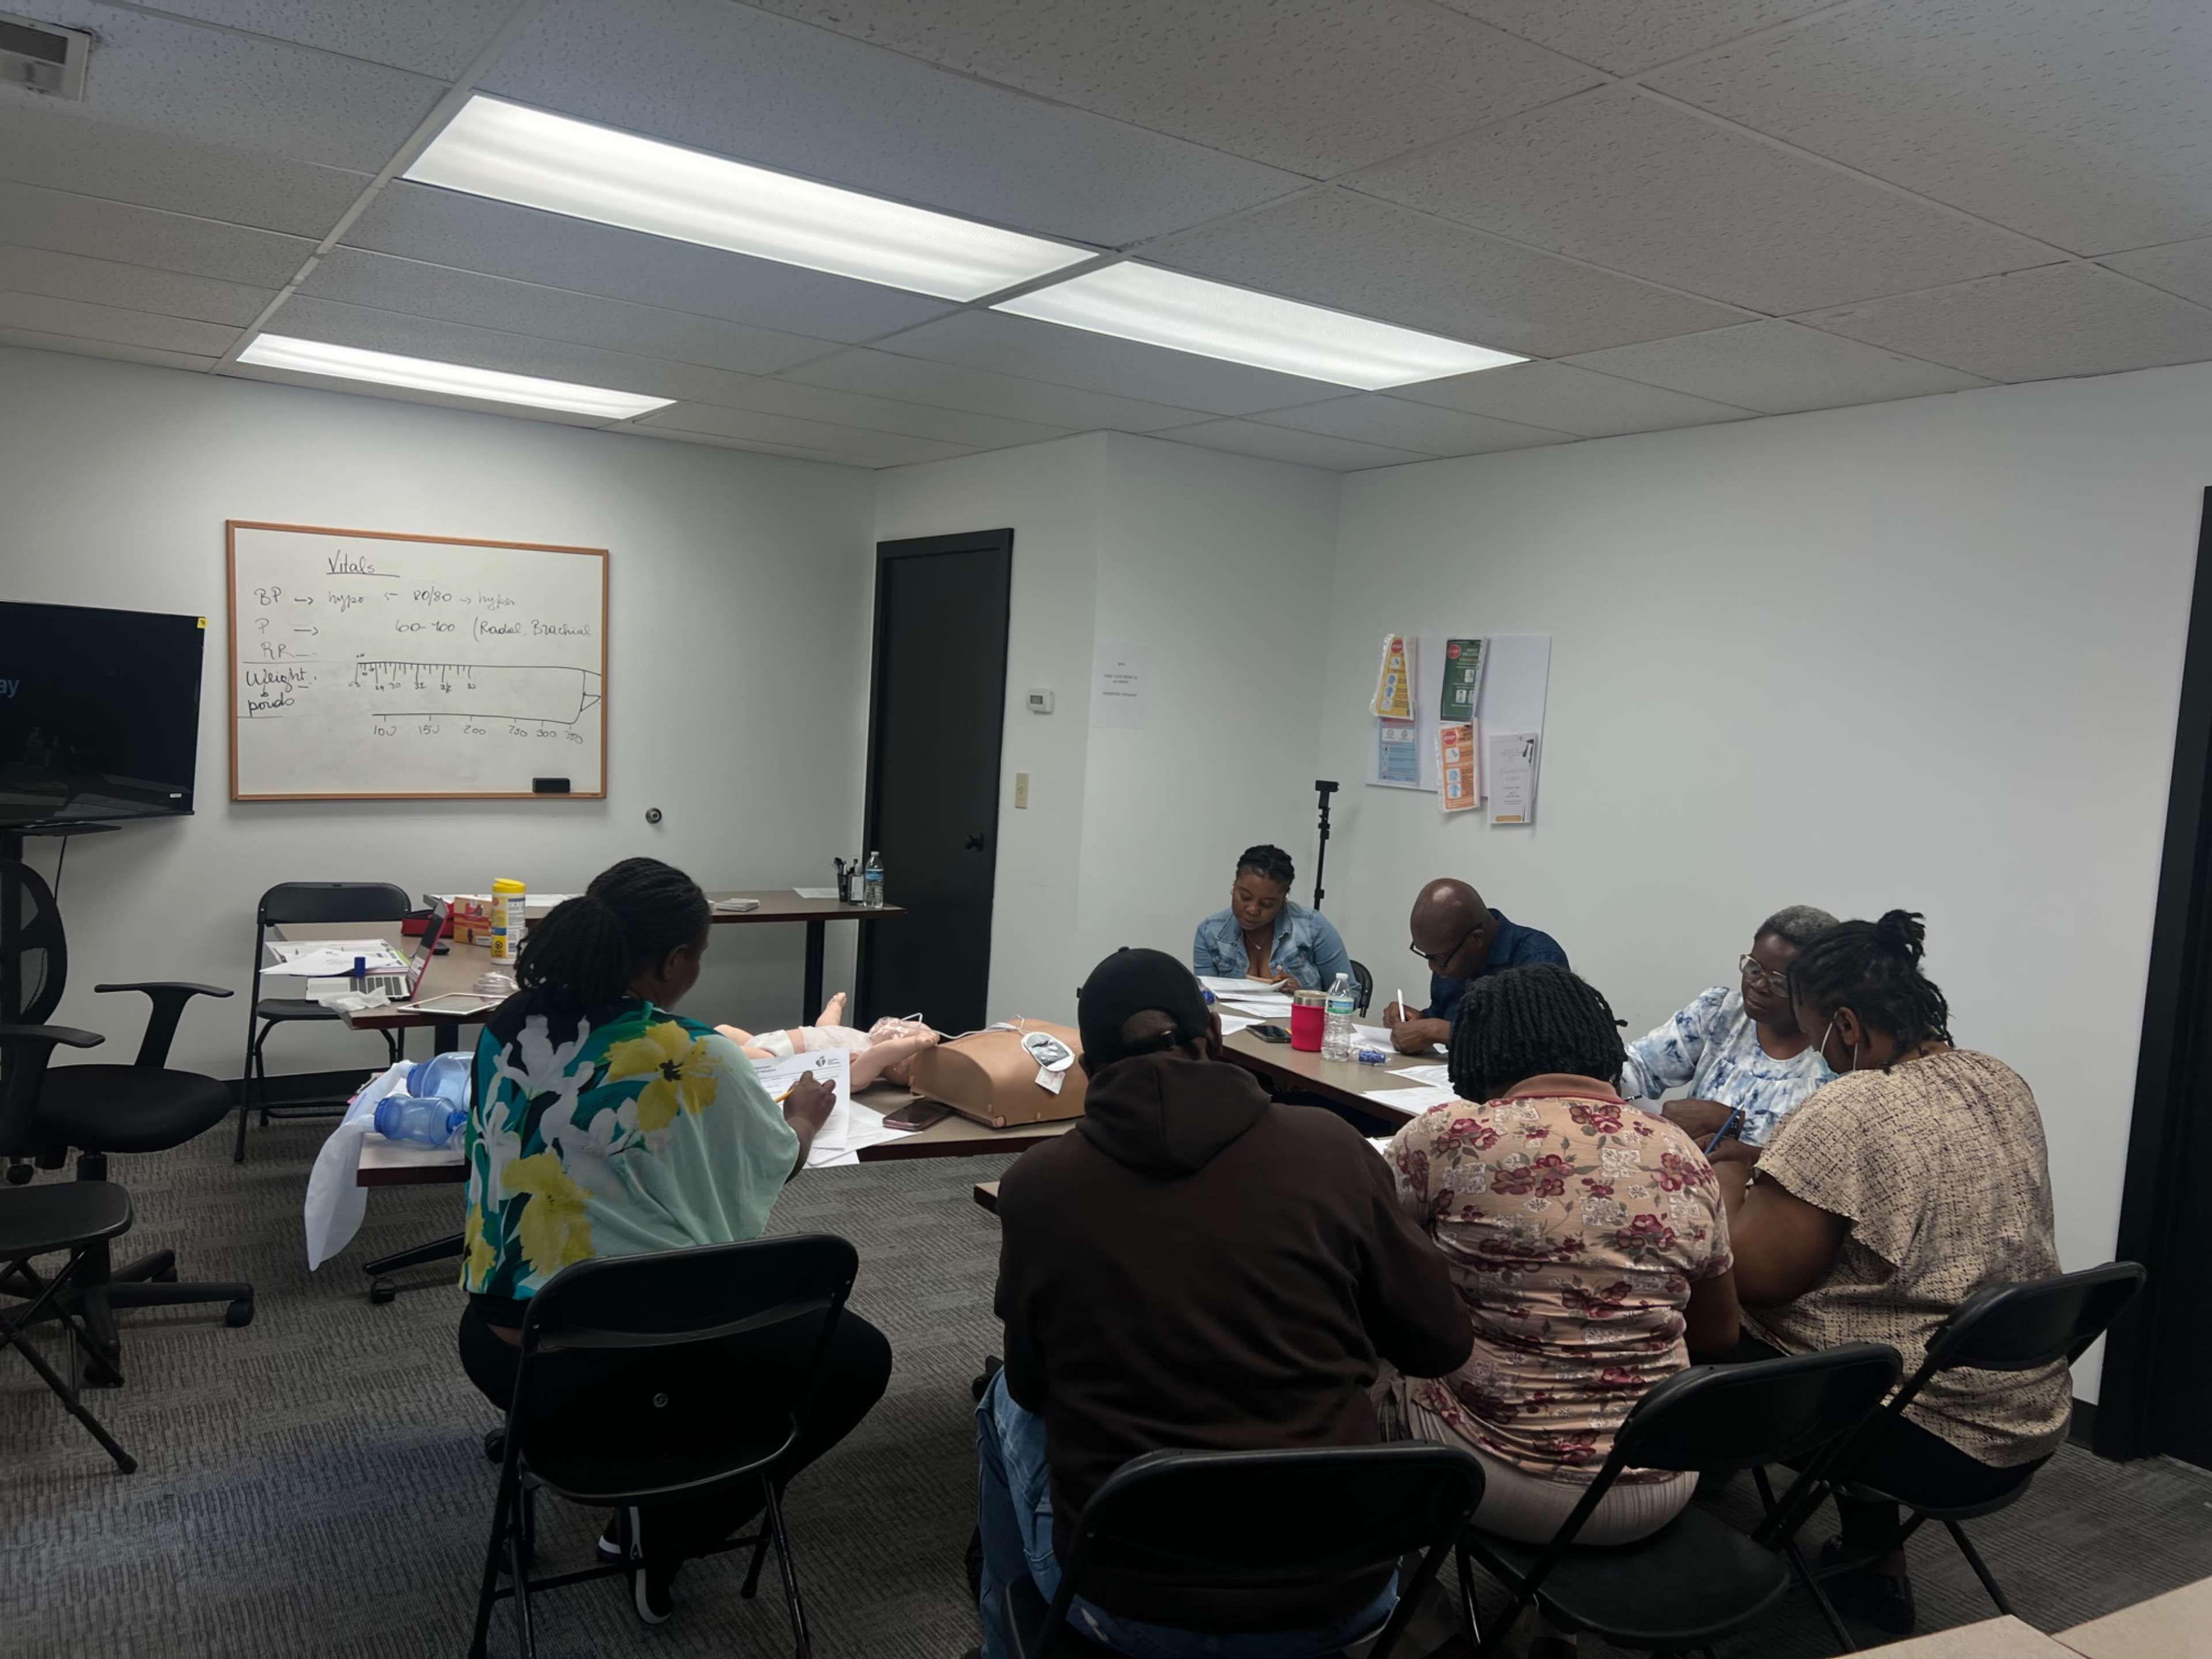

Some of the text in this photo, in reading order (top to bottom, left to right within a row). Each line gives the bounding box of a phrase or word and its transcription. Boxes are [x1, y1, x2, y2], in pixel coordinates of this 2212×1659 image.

[328, 550, 375, 575] Vitals
[254, 586, 282, 605] BP
[328, 592, 364, 612] hypo
[261, 641, 296, 660] RR
[463, 724, 486, 735] 200
